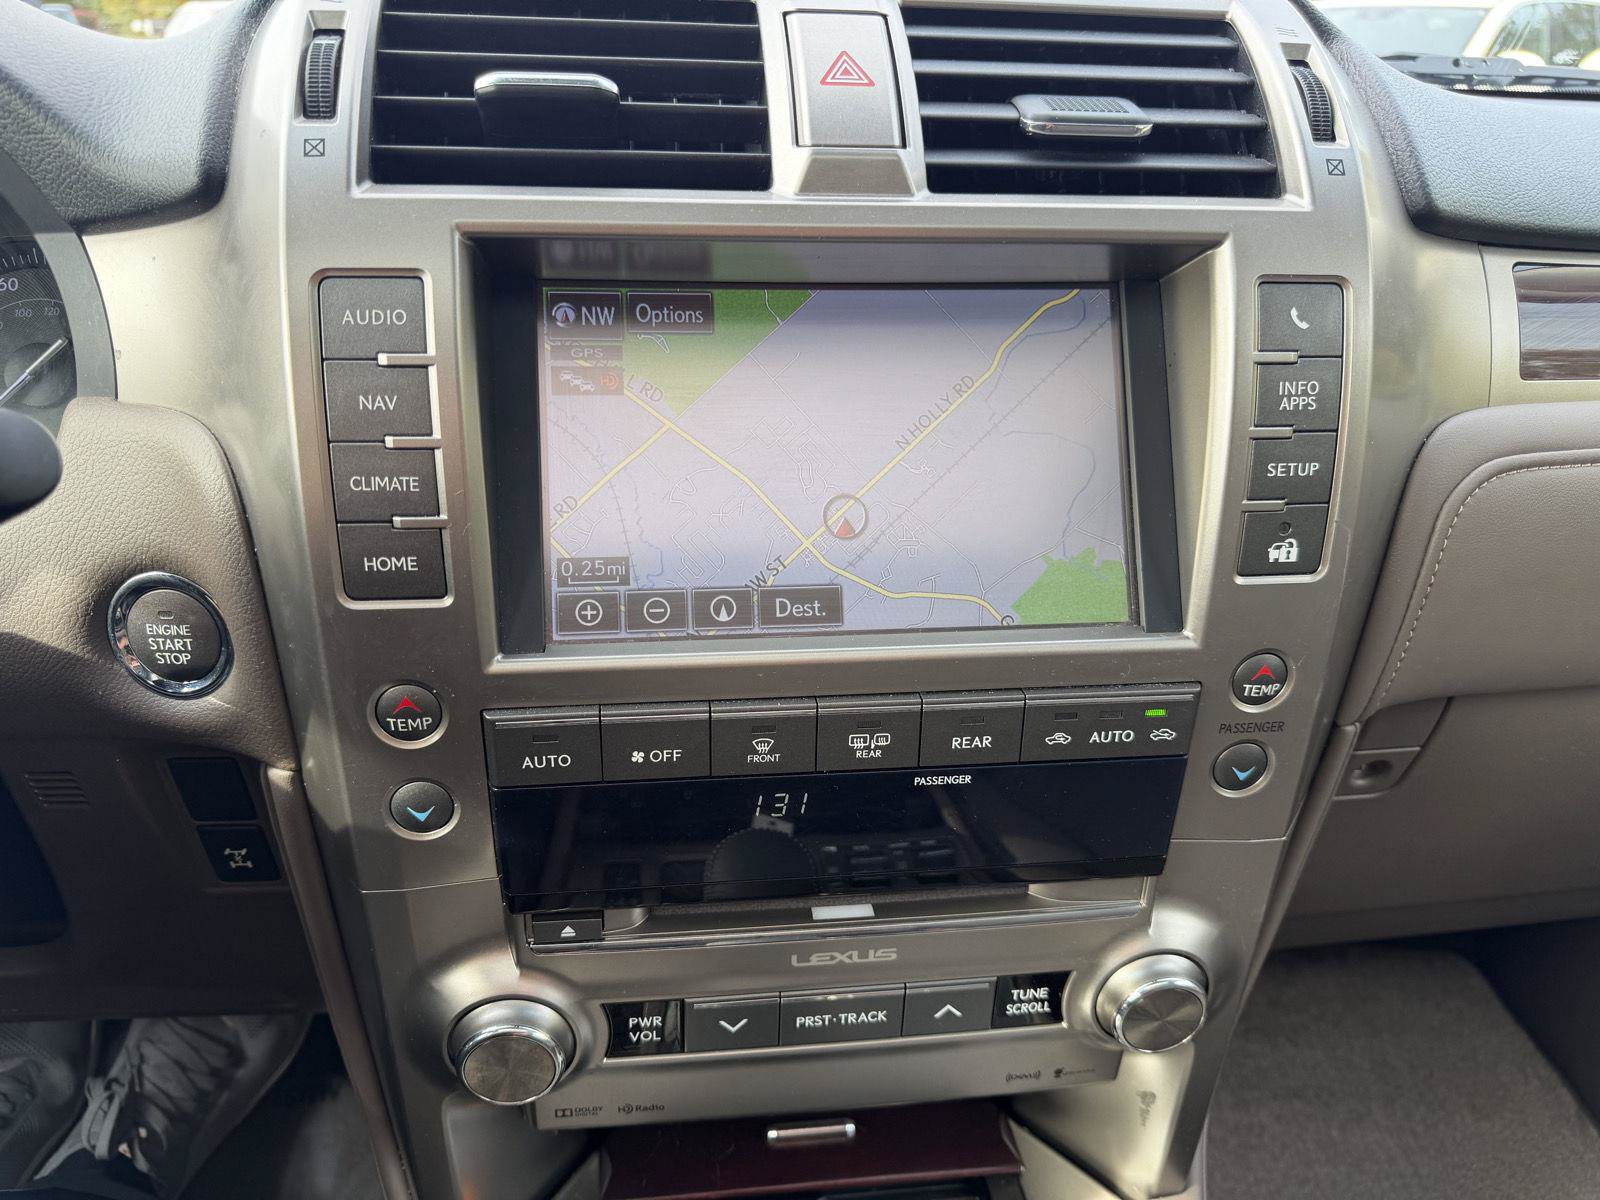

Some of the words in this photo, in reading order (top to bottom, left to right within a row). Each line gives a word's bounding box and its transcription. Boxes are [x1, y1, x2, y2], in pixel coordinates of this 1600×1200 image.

[341, 309, 407, 326] AUDIO
[581, 306, 615, 326] NW
[635, 303, 704, 327] Options
[571, 348, 604, 358] GPS
[1279, 380, 1319, 395] INFO
[359, 395, 398, 411] NAV
[907, 391, 953, 439] HOLLY
[952, 375, 975, 398] RD
[1280, 396, 1316, 410] APPS
[1267, 462, 1319, 477] SETUP
[350, 476, 420, 492] CLIMATE
[363, 556, 419, 572] HOME
[560, 560, 626, 577] 0.25mi
[766, 555, 787, 577] ST
[775, 598, 826, 618] Dest.
[146, 623, 191, 636] ENGINE
[149, 638, 193, 651] START
[156, 653, 191, 665] STOP
[1243, 683, 1281, 698] TEMP
[387, 717, 432, 732] TEMP
[1218, 721, 1285, 734] PASSENGER
[951, 736, 992, 749] REAR
[1089, 730, 1135, 744] AUTO
[649, 750, 683, 763] OFF
[747, 753, 780, 763] FRONT
[856, 749, 882, 759] REAR
[521, 755, 572, 769] AUTO
[914, 774, 972, 786] PASSENGER
[791, 948, 898, 967] LEXUS
[1011, 987, 1049, 1000] TUNE
[1005, 1001, 1051, 1017] SCROLL
[629, 1016, 662, 1028] PWR
[629, 1031, 661, 1043] VOL
[635, 1104, 665, 1112] Radio
